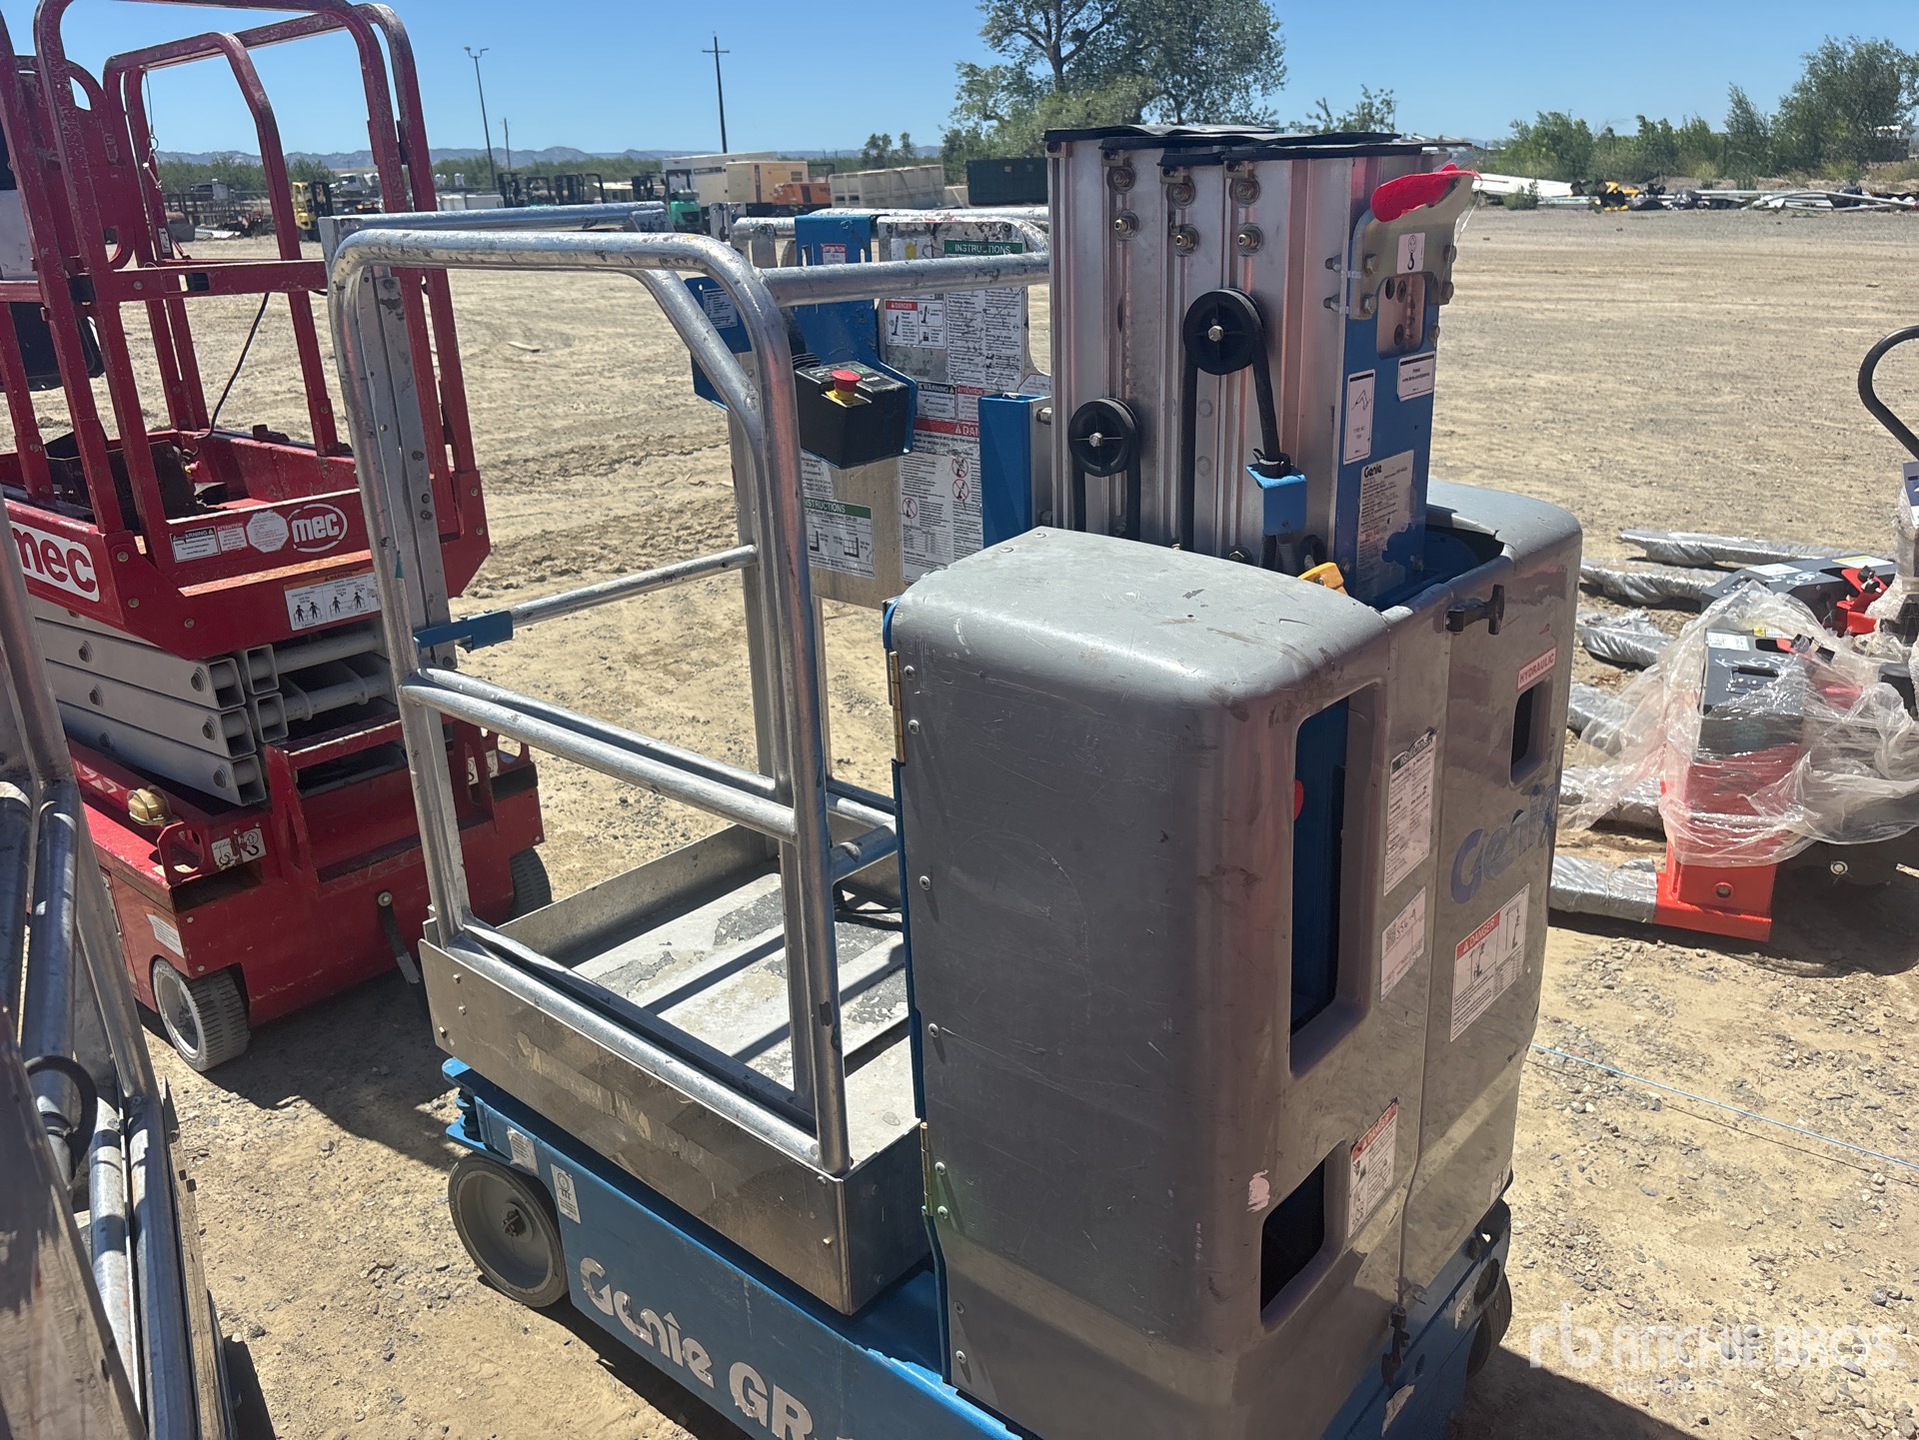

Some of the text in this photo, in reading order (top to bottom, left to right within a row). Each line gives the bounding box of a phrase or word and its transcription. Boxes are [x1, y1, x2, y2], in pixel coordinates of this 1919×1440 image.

[954, 243, 1011, 254] INSTRUTIONS
[1364, 463, 1382, 478] Genie
[185, 530, 208, 540] ARNING
[291, 513, 340, 543] mec
[1519, 652, 1555, 684] HYDRAULIC
[1469, 918, 1494, 948] DANGER
[580, 1257, 853, 1440] Genie GR
